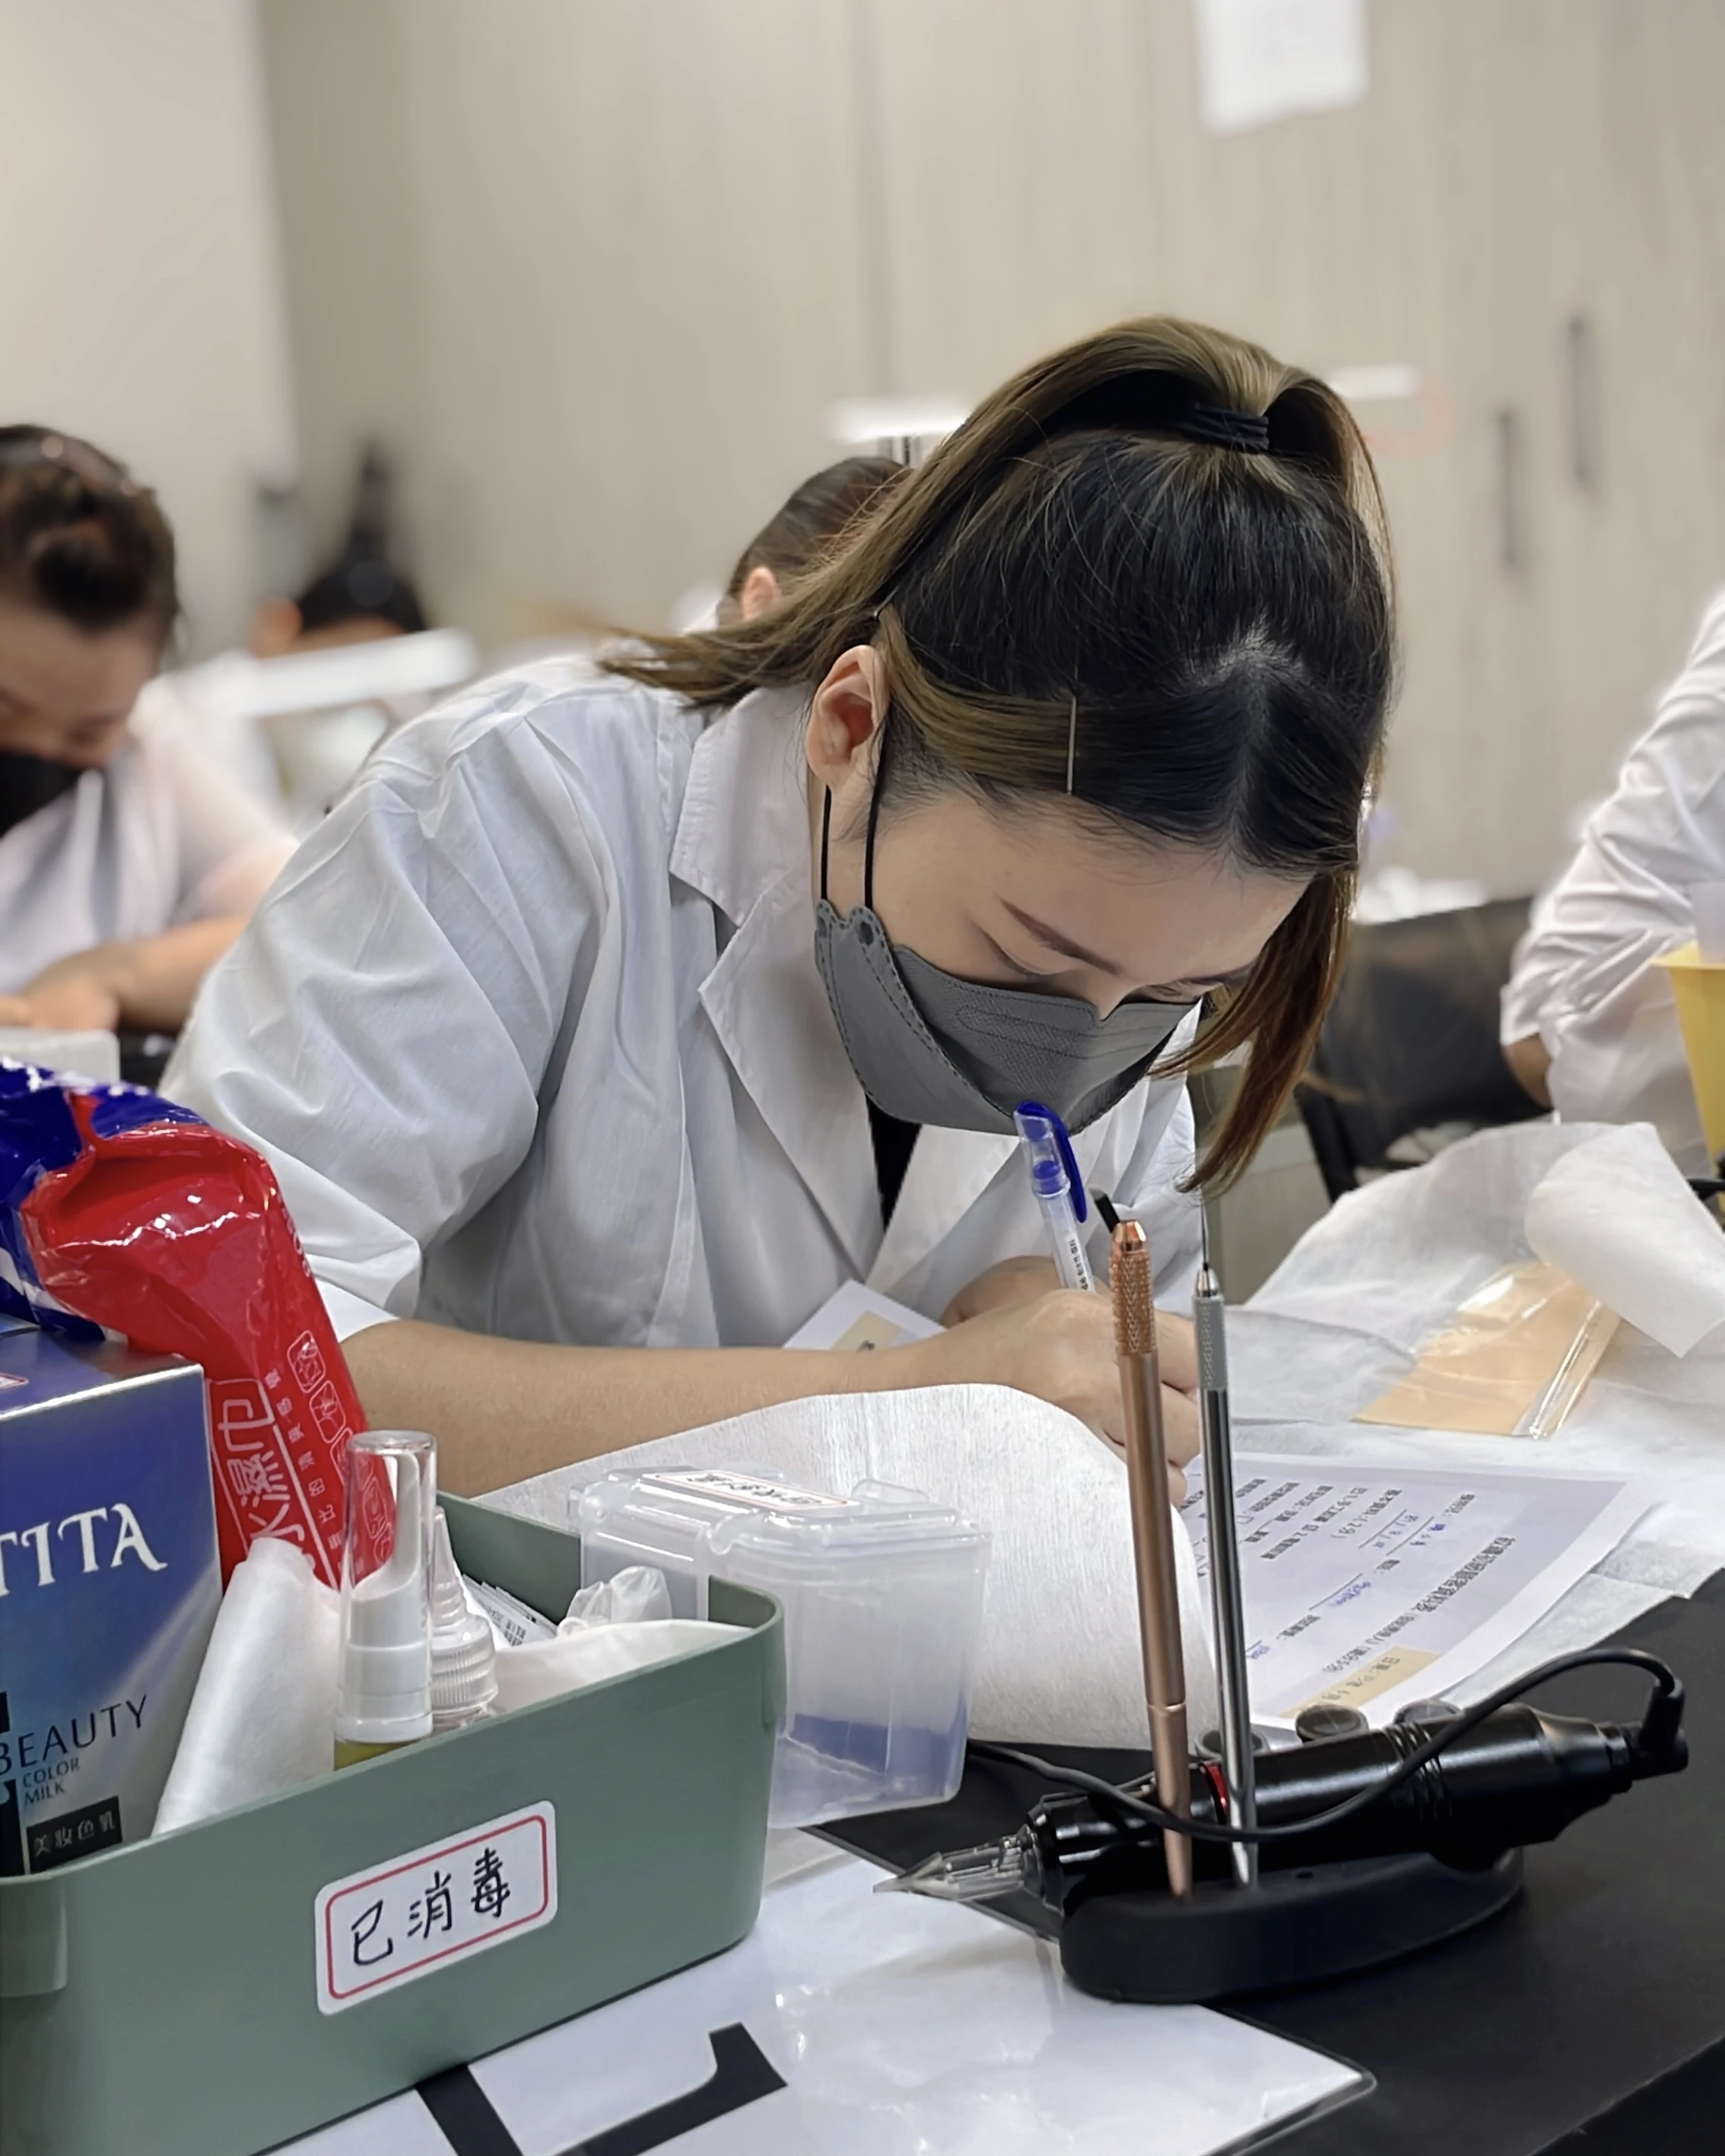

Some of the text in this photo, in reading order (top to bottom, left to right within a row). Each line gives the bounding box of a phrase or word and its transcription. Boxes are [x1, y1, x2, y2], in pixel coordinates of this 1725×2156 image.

[218, 1399, 315, 1570] 水濕巾
[0, 1694, 147, 1776] BEAUTY
[23, 1757, 81, 1787] COLOR
[24, 1780, 65, 1808] MILK
